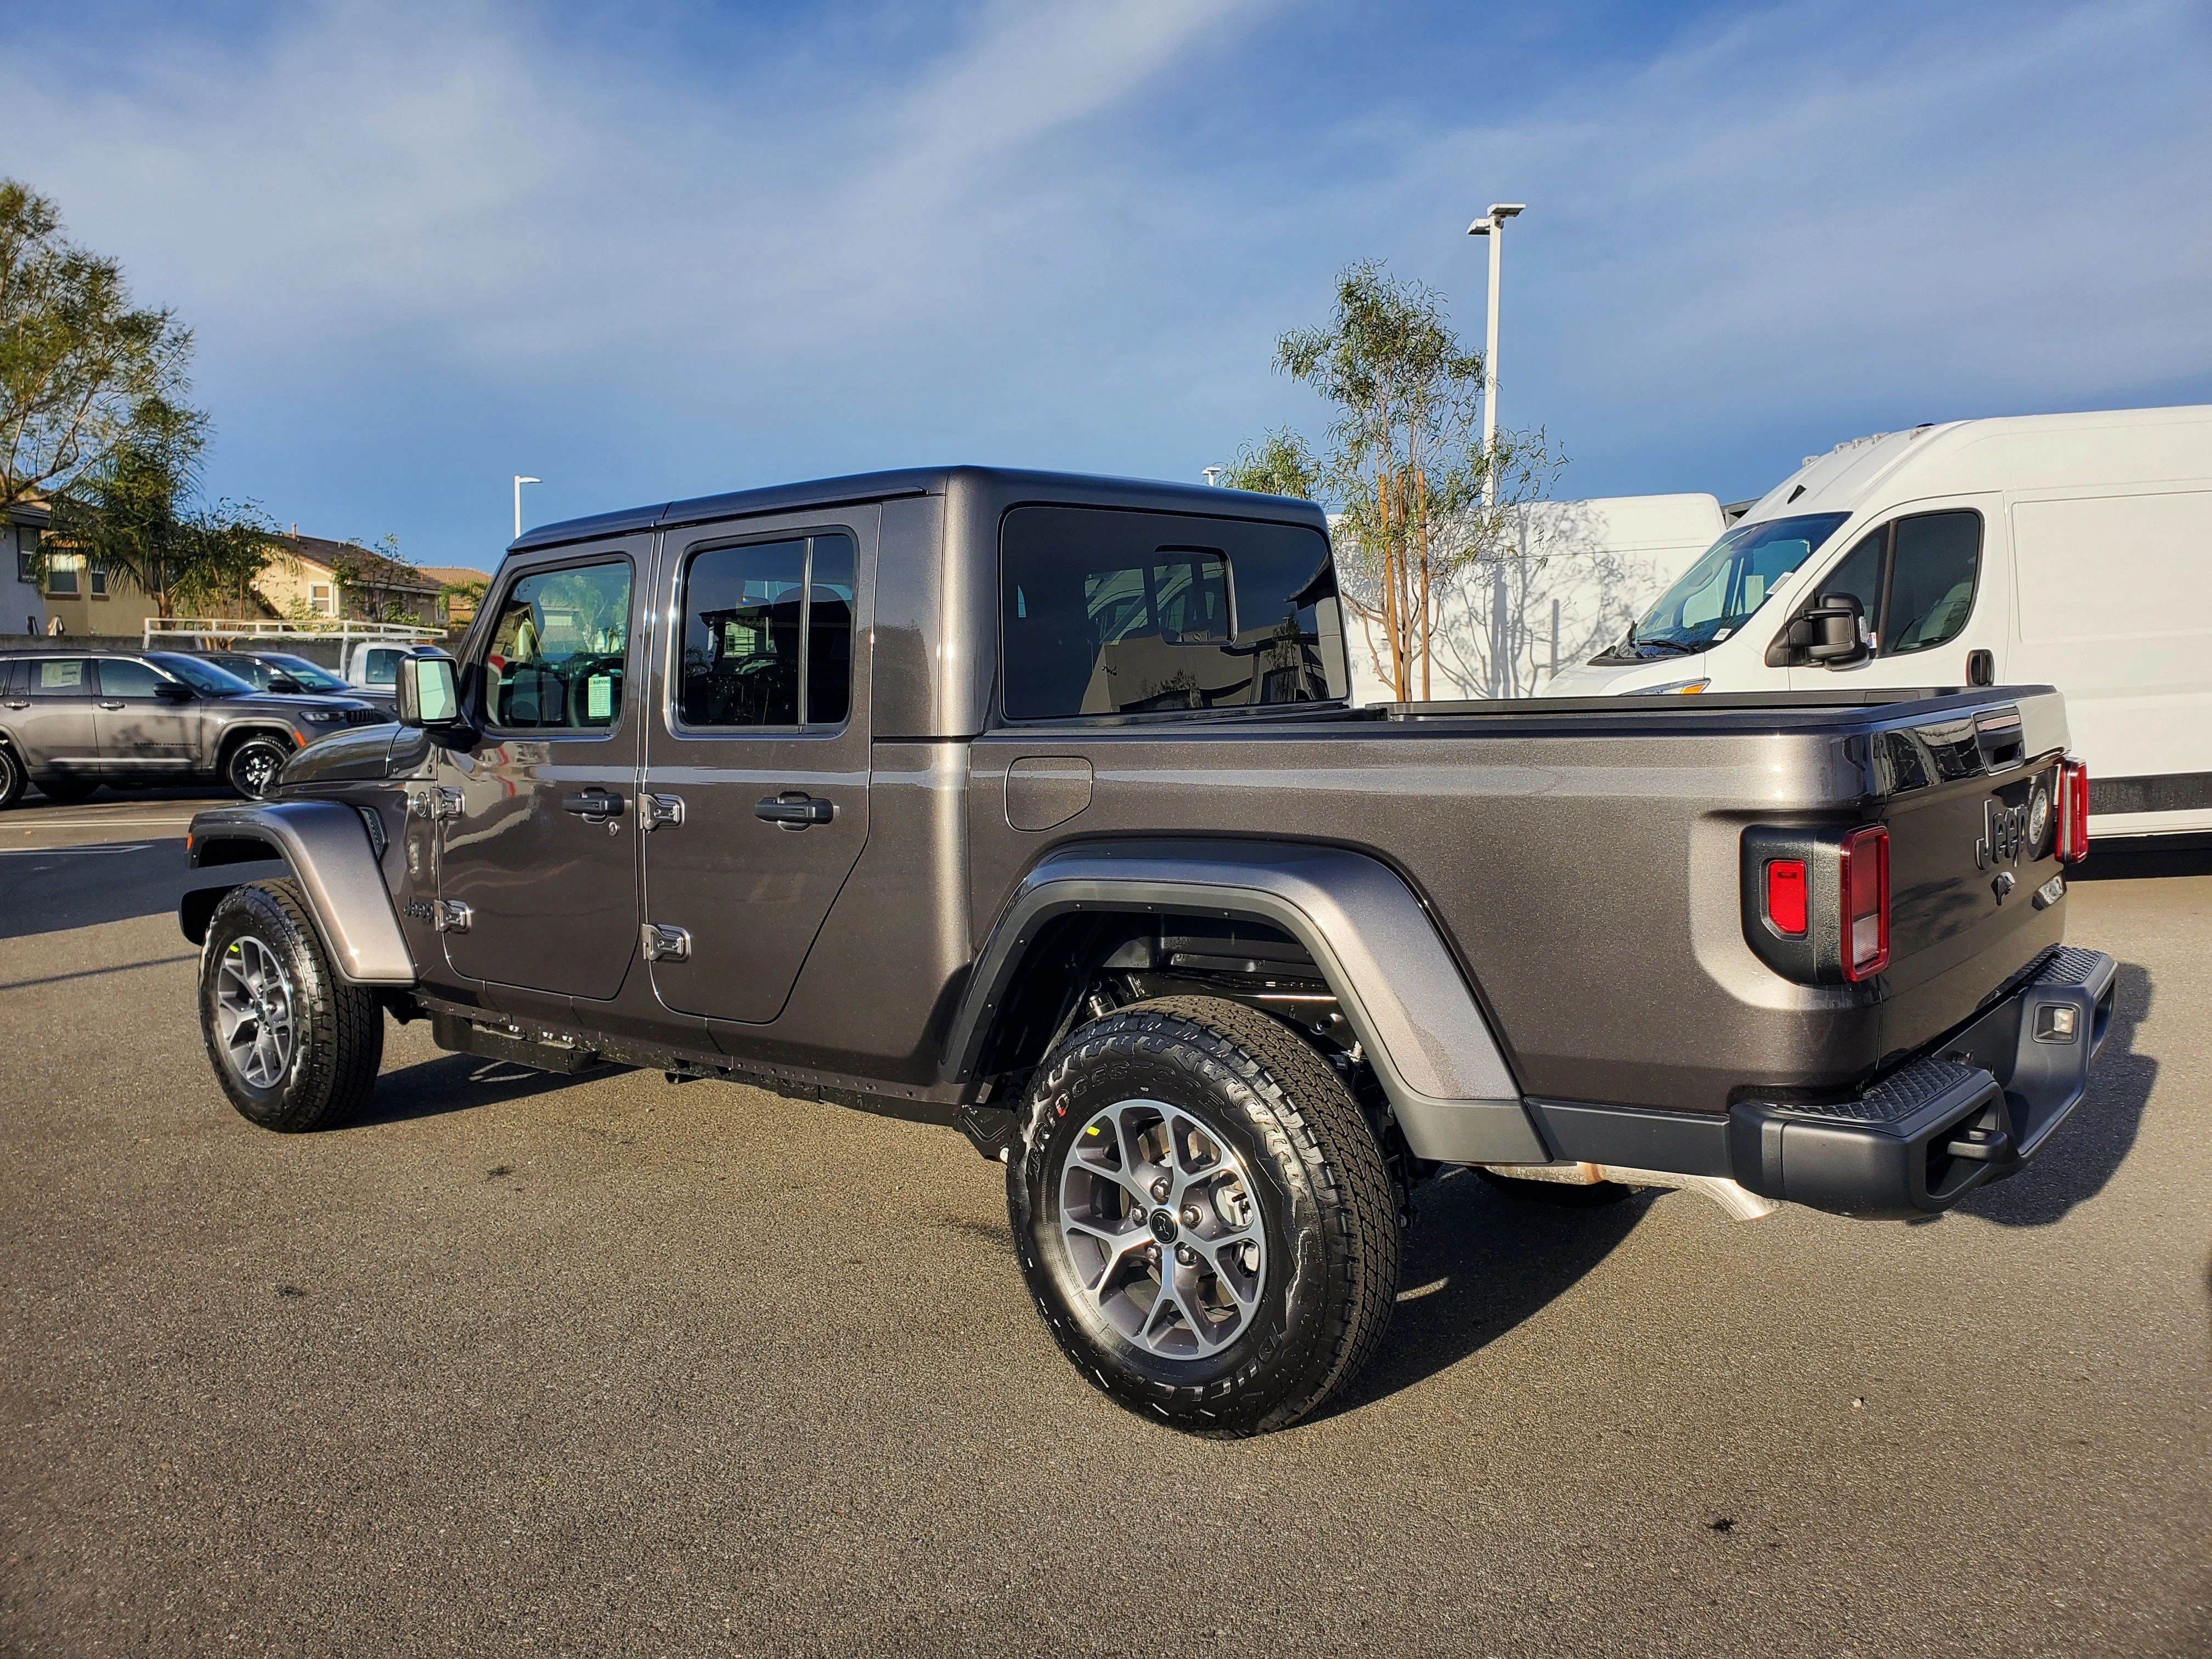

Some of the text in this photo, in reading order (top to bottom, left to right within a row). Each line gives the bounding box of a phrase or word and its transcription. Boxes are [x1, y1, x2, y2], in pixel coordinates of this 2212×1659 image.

[1975, 799, 2029, 870] Jeep
[403, 895, 434, 924] Jeep
[1026, 1060, 1225, 1183] BRIDGESTONE
